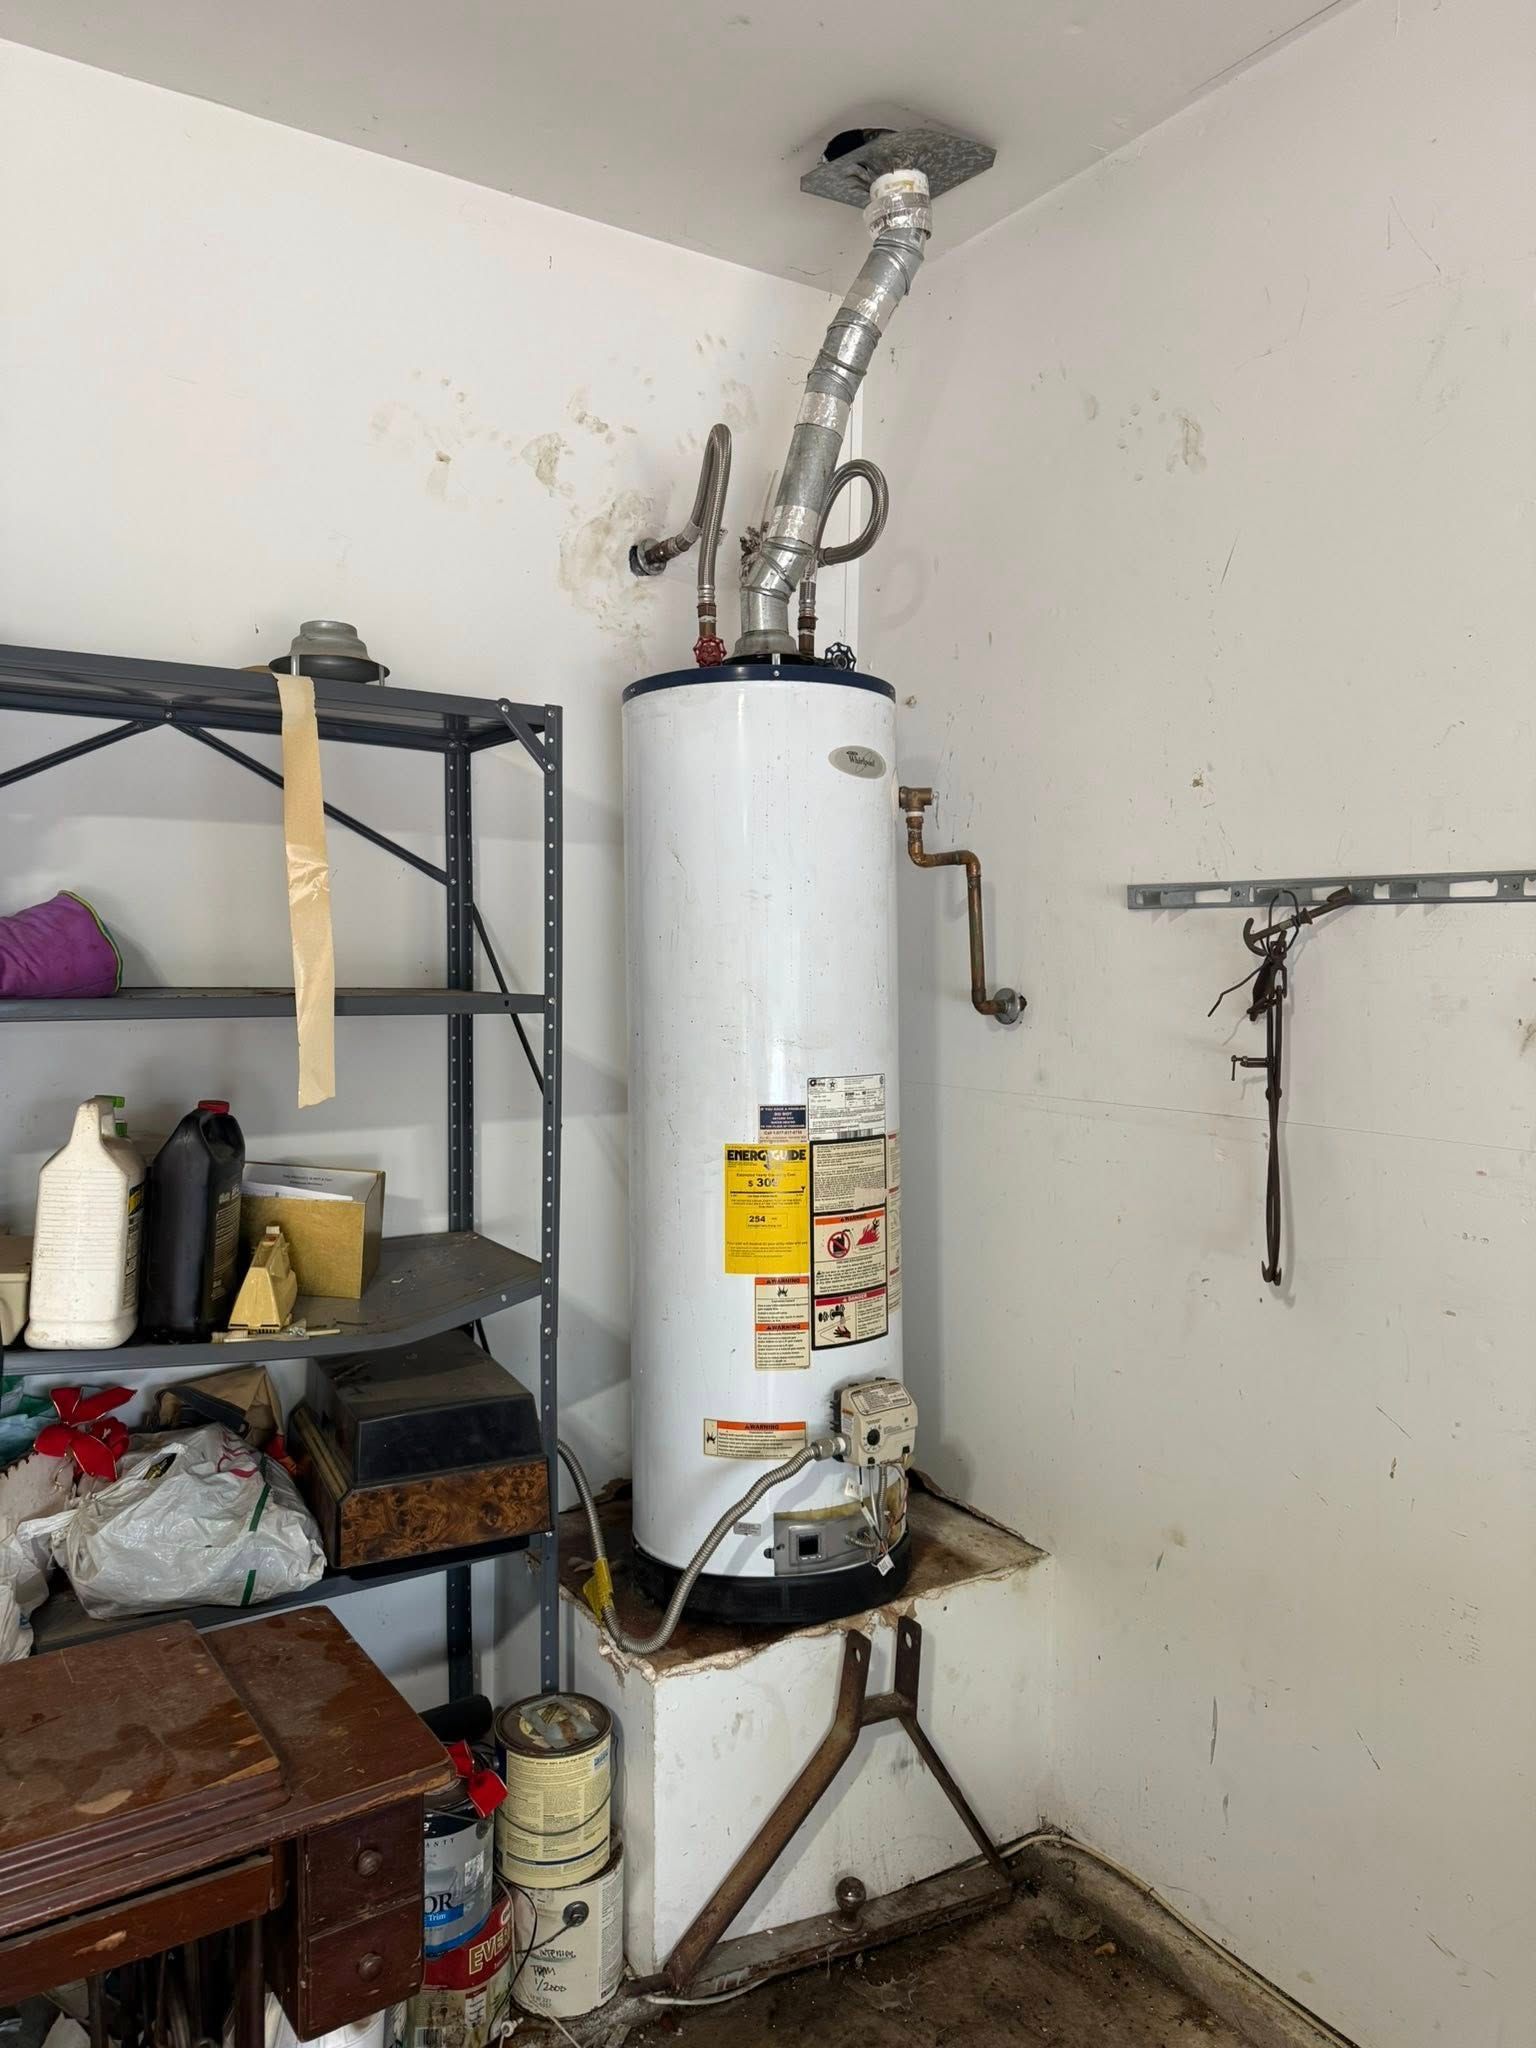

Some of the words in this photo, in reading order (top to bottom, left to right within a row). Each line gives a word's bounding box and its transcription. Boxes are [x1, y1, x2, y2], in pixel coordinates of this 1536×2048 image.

[848, 755, 875, 767] Whirlpool
[727, 1149, 806, 1161] ENERGGUDE
[429, 1913, 446, 1922] Trim
